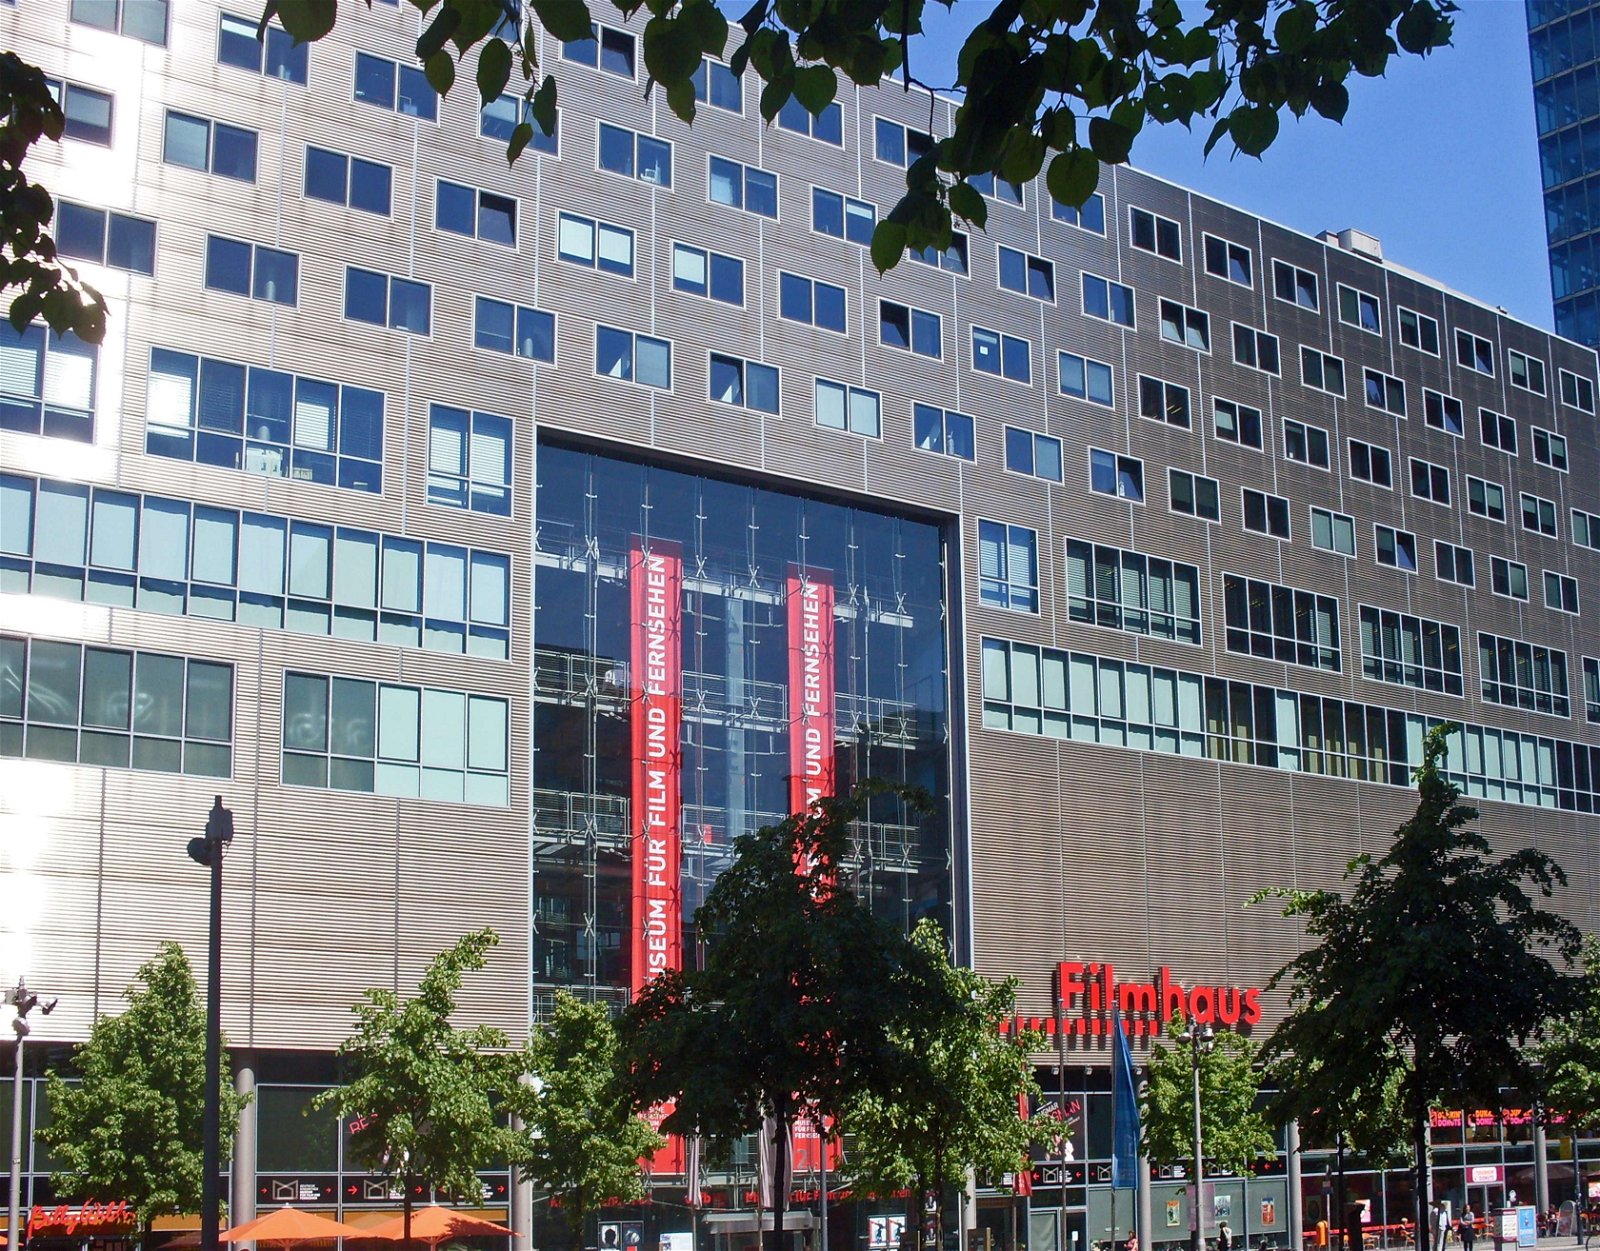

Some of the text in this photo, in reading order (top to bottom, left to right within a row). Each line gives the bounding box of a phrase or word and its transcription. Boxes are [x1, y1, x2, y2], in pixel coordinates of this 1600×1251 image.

[803, 582, 821, 717] FERNSEHEN
[643, 556, 667, 983] USEUM FÜR FILM UND FERNSEHEN
[805, 728, 822, 776] UND
[1059, 962, 1262, 1025] Filmhaus
